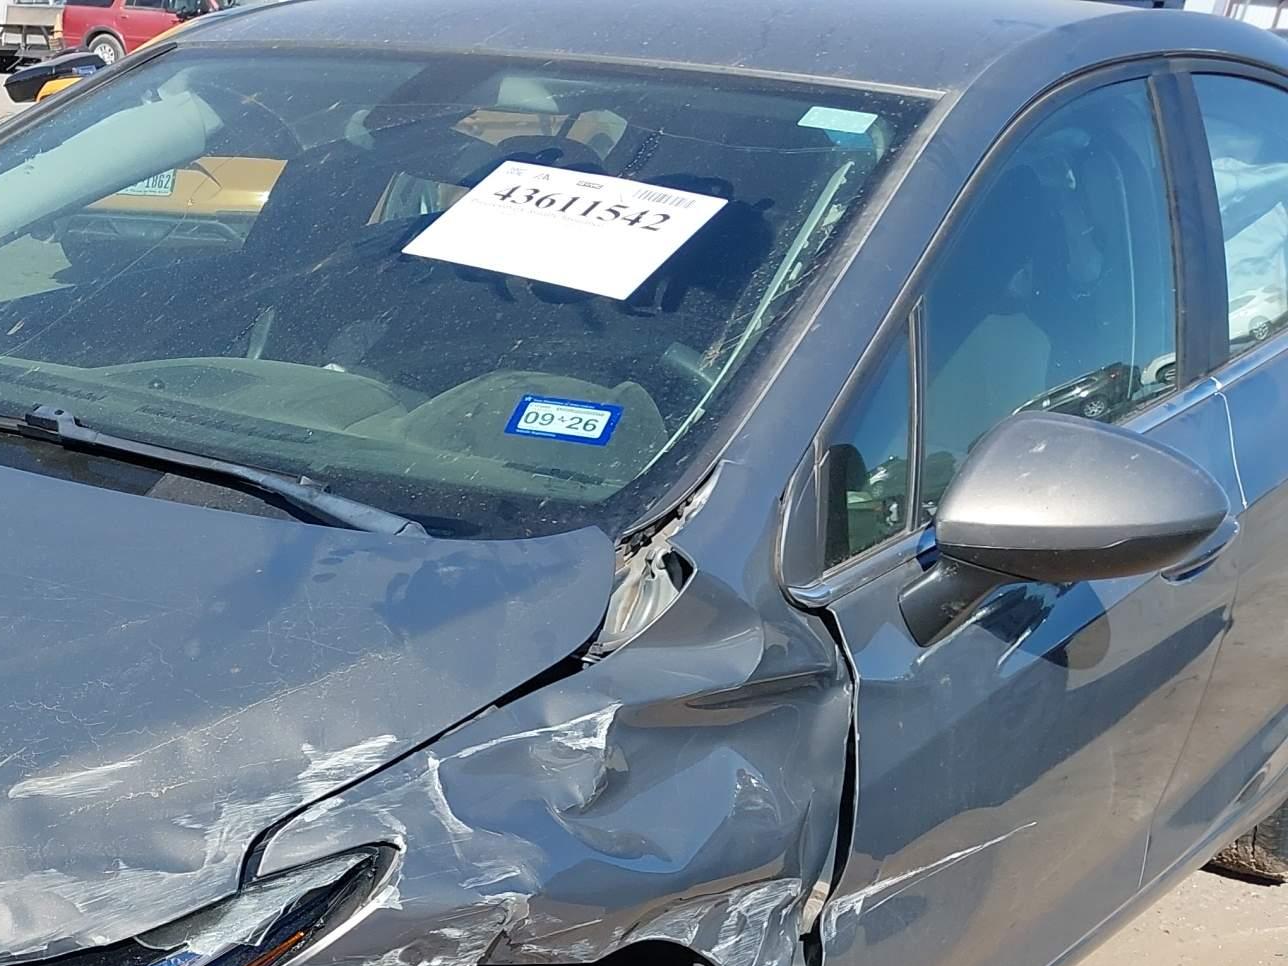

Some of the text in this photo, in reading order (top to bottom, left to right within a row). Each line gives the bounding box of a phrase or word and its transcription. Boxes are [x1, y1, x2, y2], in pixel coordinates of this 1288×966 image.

[494, 185, 671, 231] 43611542
[523, 411, 599, 432] 09 26
